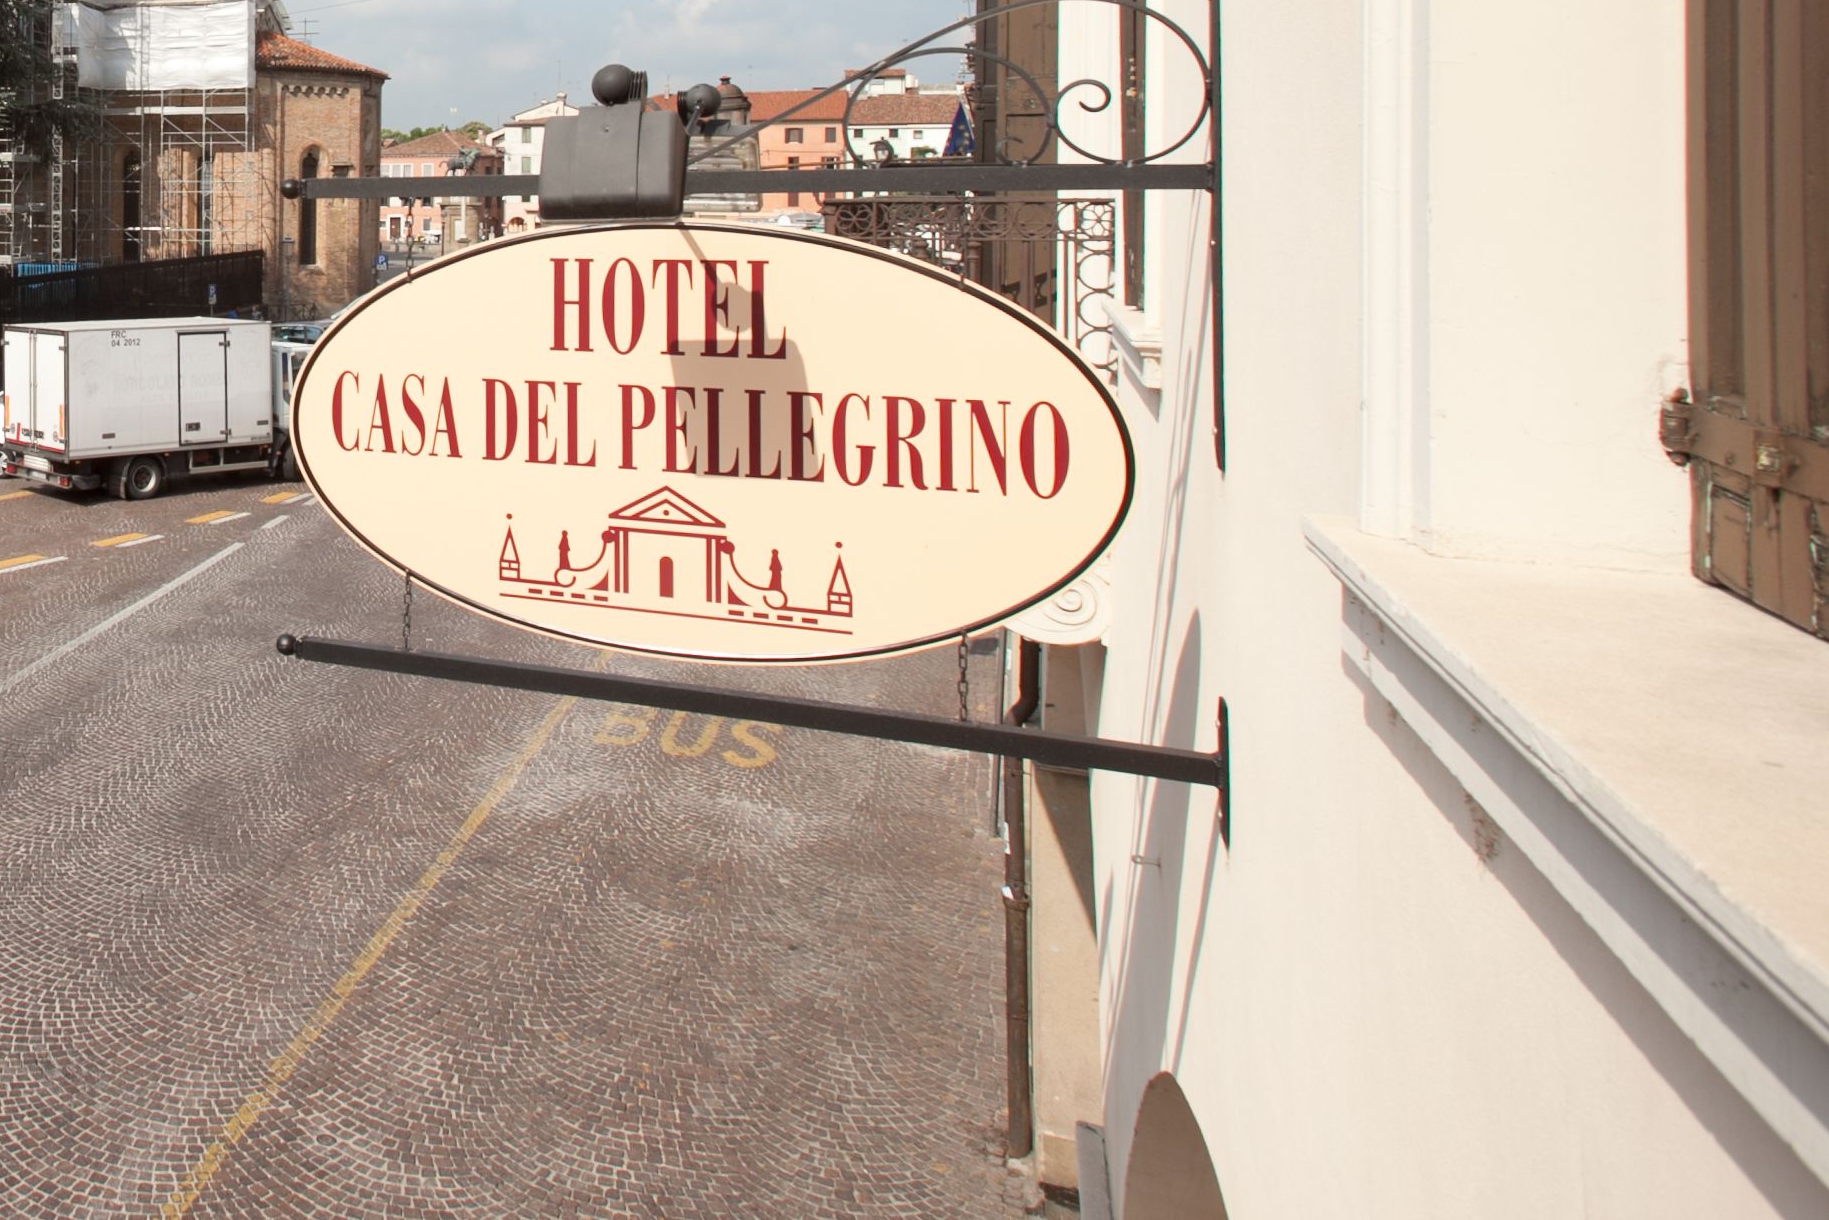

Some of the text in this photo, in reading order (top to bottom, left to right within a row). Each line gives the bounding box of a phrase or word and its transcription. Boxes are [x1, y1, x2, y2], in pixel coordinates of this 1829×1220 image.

[111, 330, 127, 339] FRC
[549, 257, 787, 360] HOTEL
[111, 338, 141, 347] 04 2012
[331, 369, 1070, 500] CASA DEL PELLEGRINO
[593, 706, 783, 768] BUS
